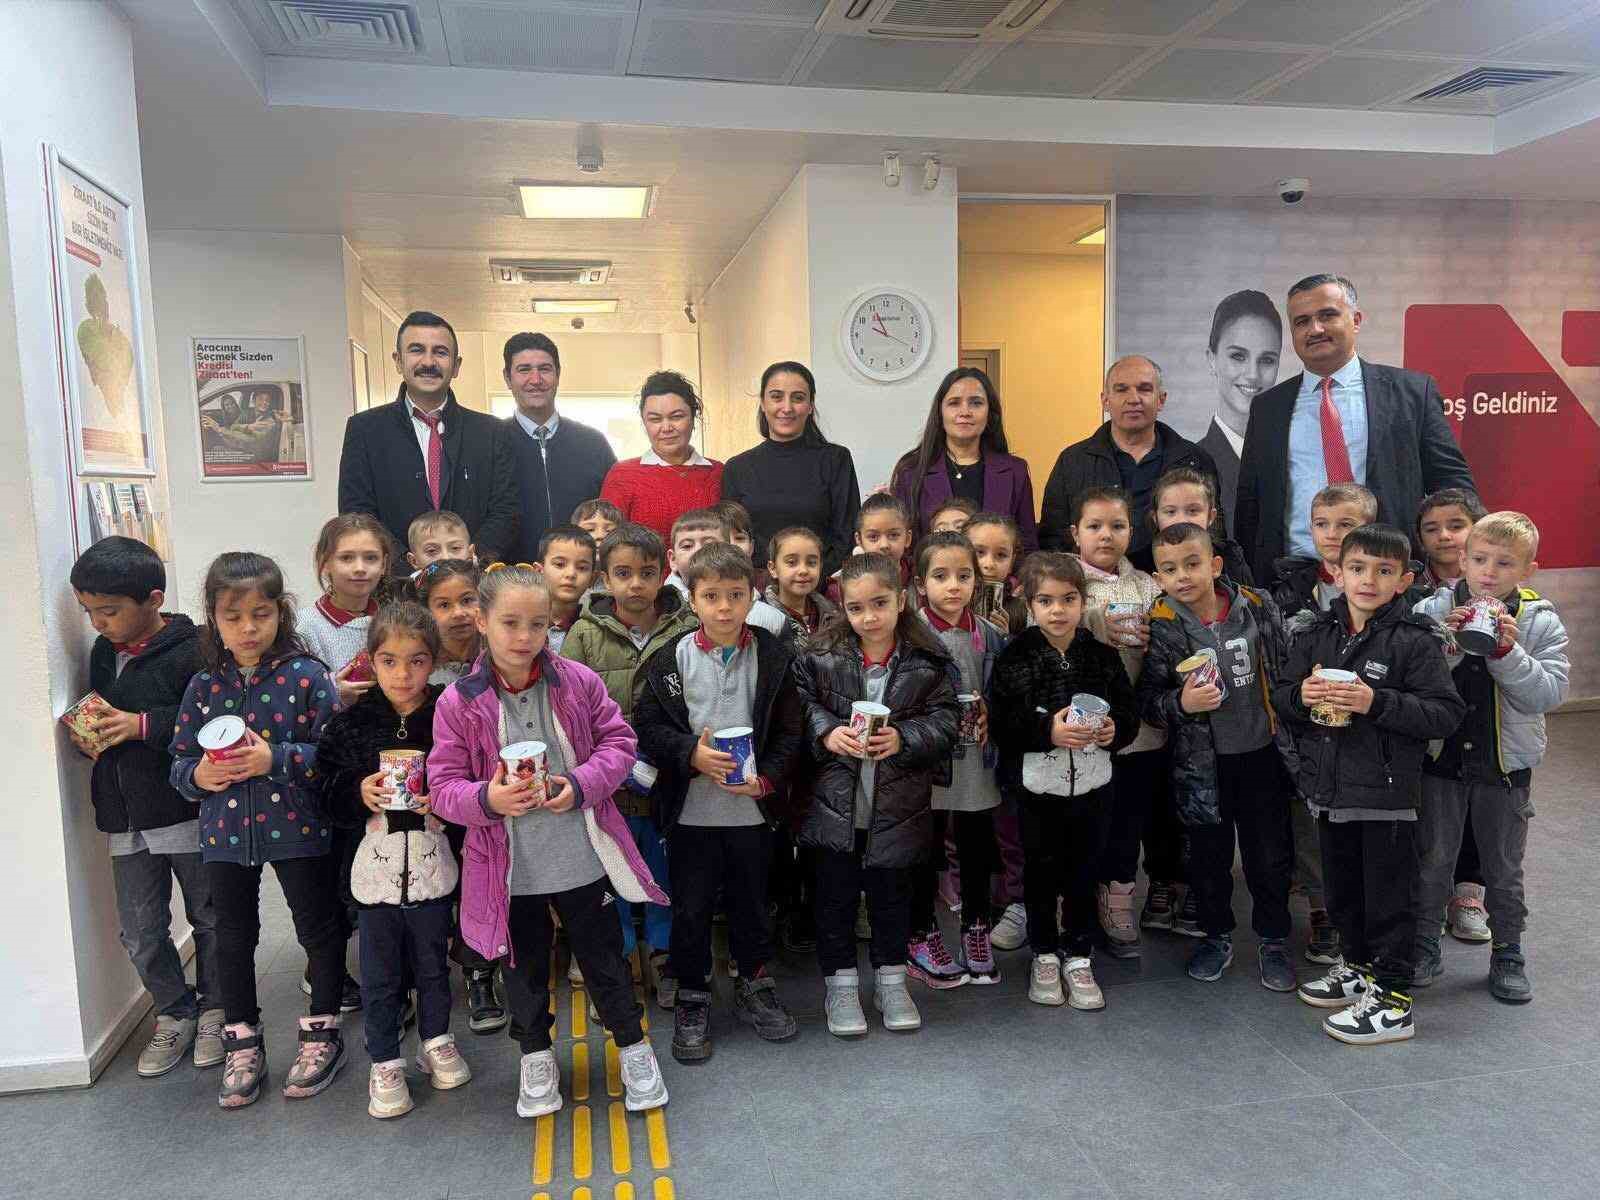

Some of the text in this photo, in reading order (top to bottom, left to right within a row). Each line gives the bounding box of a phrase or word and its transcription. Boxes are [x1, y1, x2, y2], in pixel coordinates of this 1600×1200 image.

[239, 352, 273, 361] Sizden
[1443, 391, 1558, 421] oş Geldiniz
[1225, 637, 1250, 675] 3
